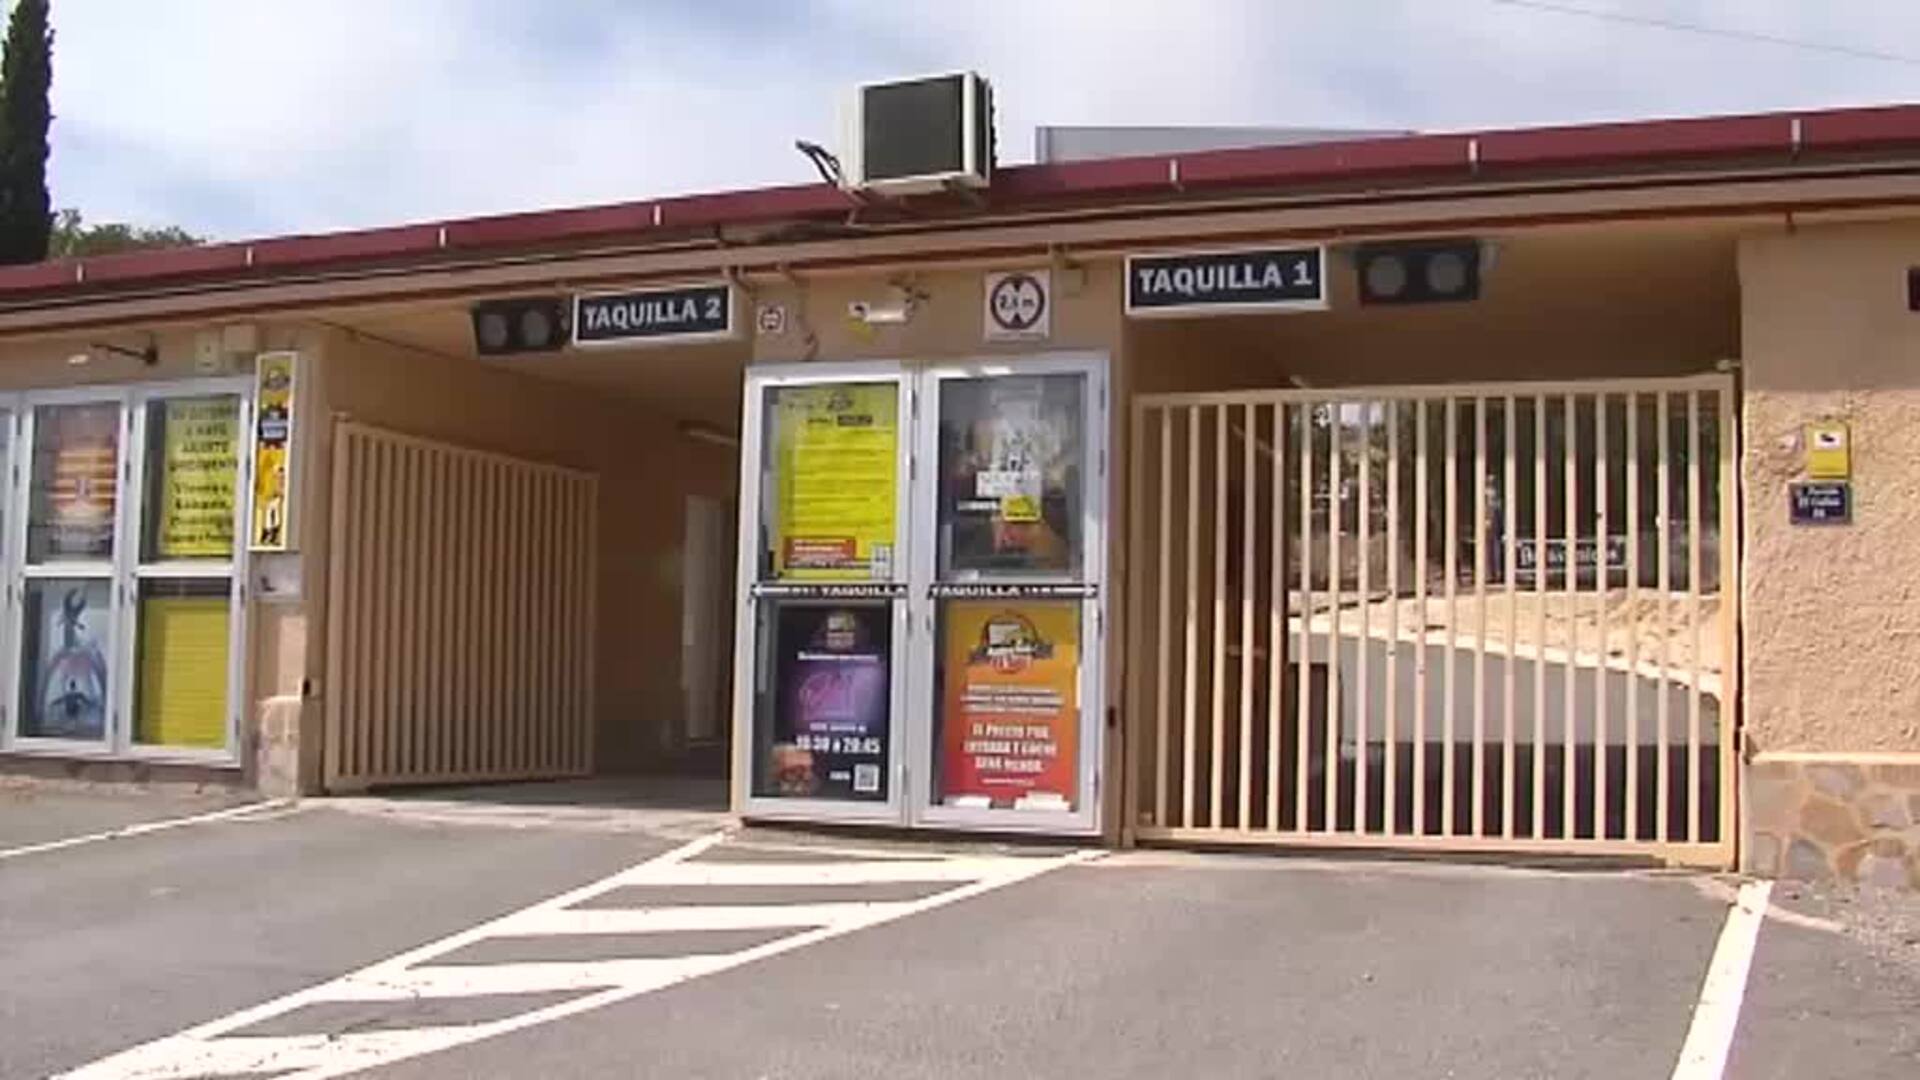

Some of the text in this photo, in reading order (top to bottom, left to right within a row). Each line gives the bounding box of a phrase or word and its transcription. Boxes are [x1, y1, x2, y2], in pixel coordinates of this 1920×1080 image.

[1138, 260, 1313, 296] TAQUILLA 1
[583, 296, 721, 330] TAQUILLA 2
[821, 585, 906, 596] TAQUILLA
[931, 585, 1020, 596] TAQUILLA
[986, 724, 1025, 739] PRECIO
[1027, 725, 1050, 740] POR
[964, 739, 1011, 754] ENTRADA
[1021, 741, 1057, 758] COCHE
